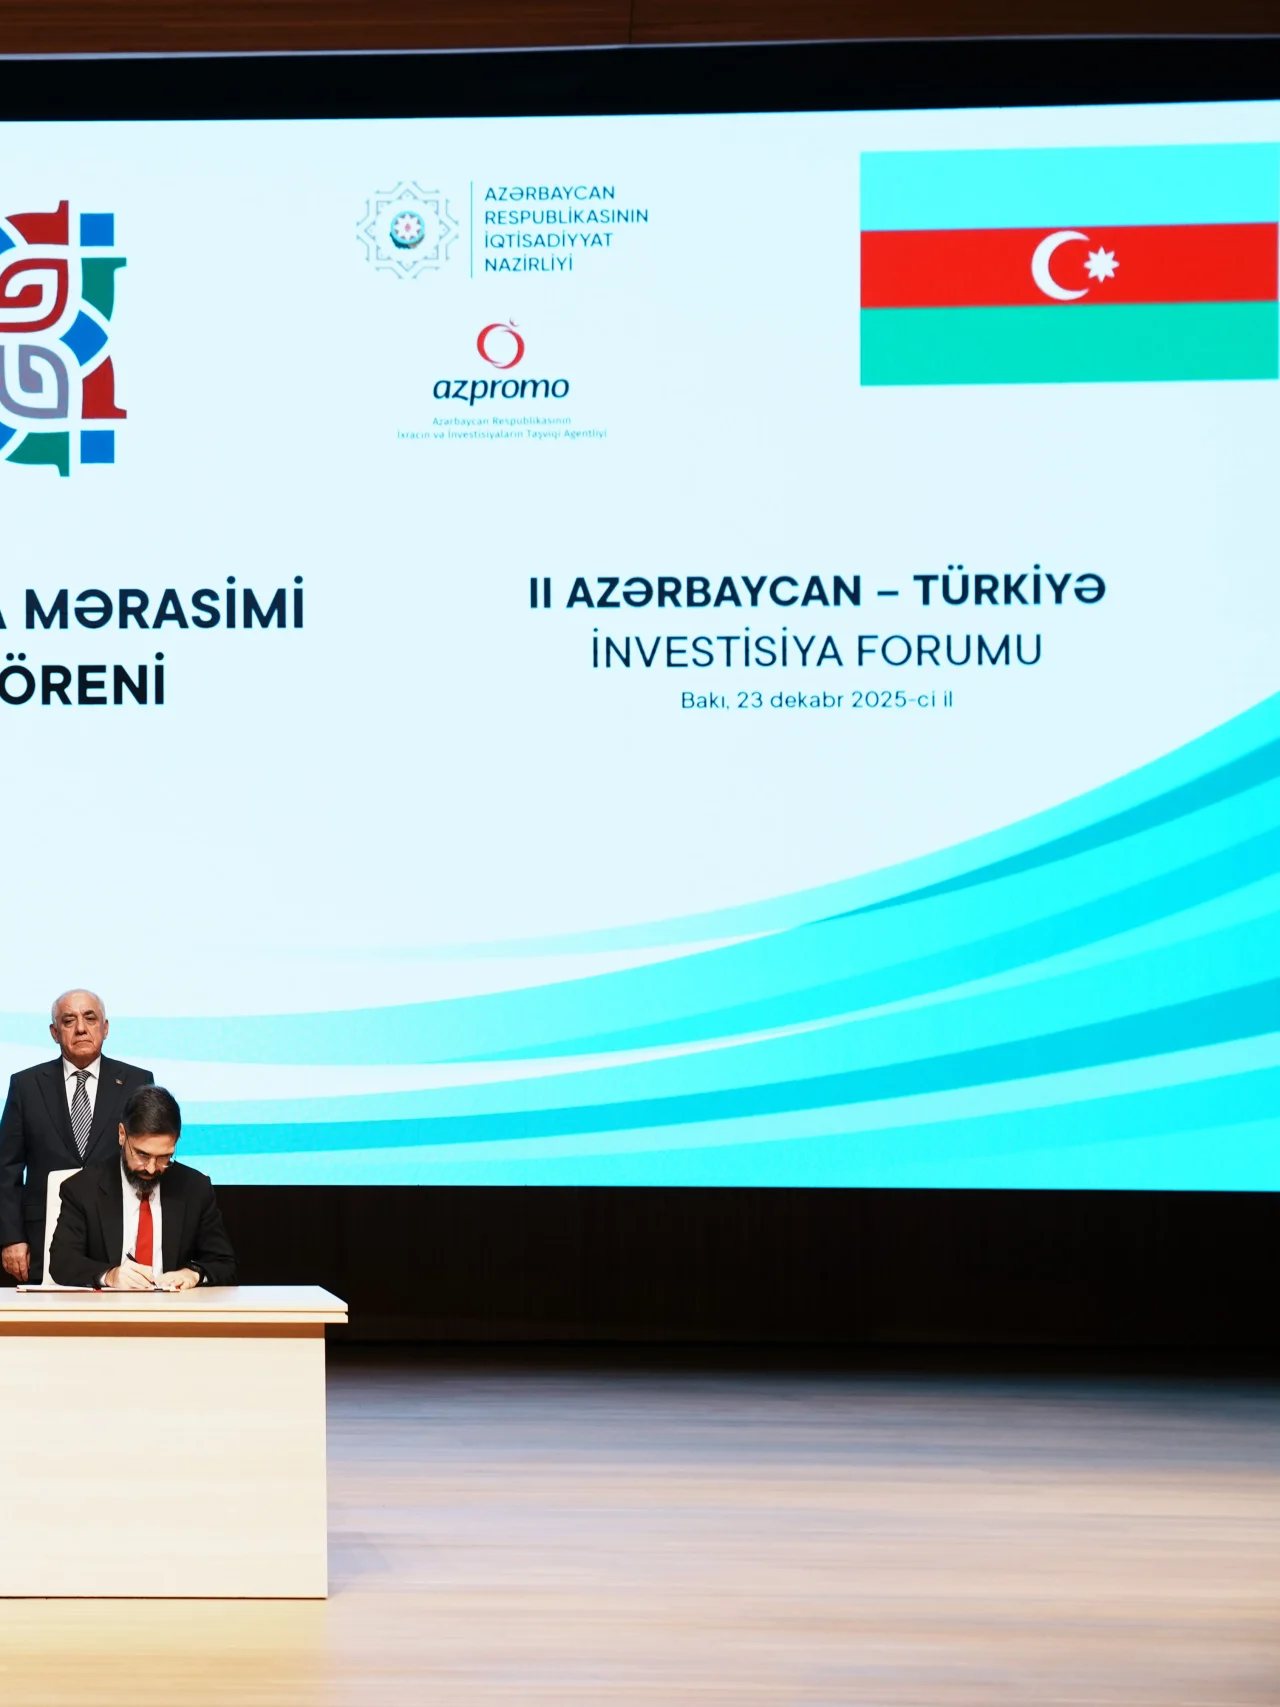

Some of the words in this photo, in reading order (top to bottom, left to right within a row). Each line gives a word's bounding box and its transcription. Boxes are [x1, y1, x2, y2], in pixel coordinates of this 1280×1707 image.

[484, 185, 615, 201] AZƏRBAYCAN
[485, 206, 649, 225] RESPUBLİKASININ
[484, 230, 613, 249] İQTİSADİYYAT
[484, 253, 573, 273] NAZİRLİYİ
[432, 378, 570, 407] azpromo
[529, 576, 552, 609] II
[565, 574, 861, 609] AZƏRBAYCAN
[912, 563, 1107, 607] TÜRKİYƏ
[25, 574, 304, 630] MƏRASİMİ
[592, 626, 844, 669] İNVESTİSİYA
[857, 633, 1042, 667] FORUMU
[681, 691, 730, 710] Bakı,
[737, 691, 764, 709] 23
[769, 691, 844, 709] dekabr
[851, 690, 936, 709] 2025-ci
[943, 690, 953, 708] il
